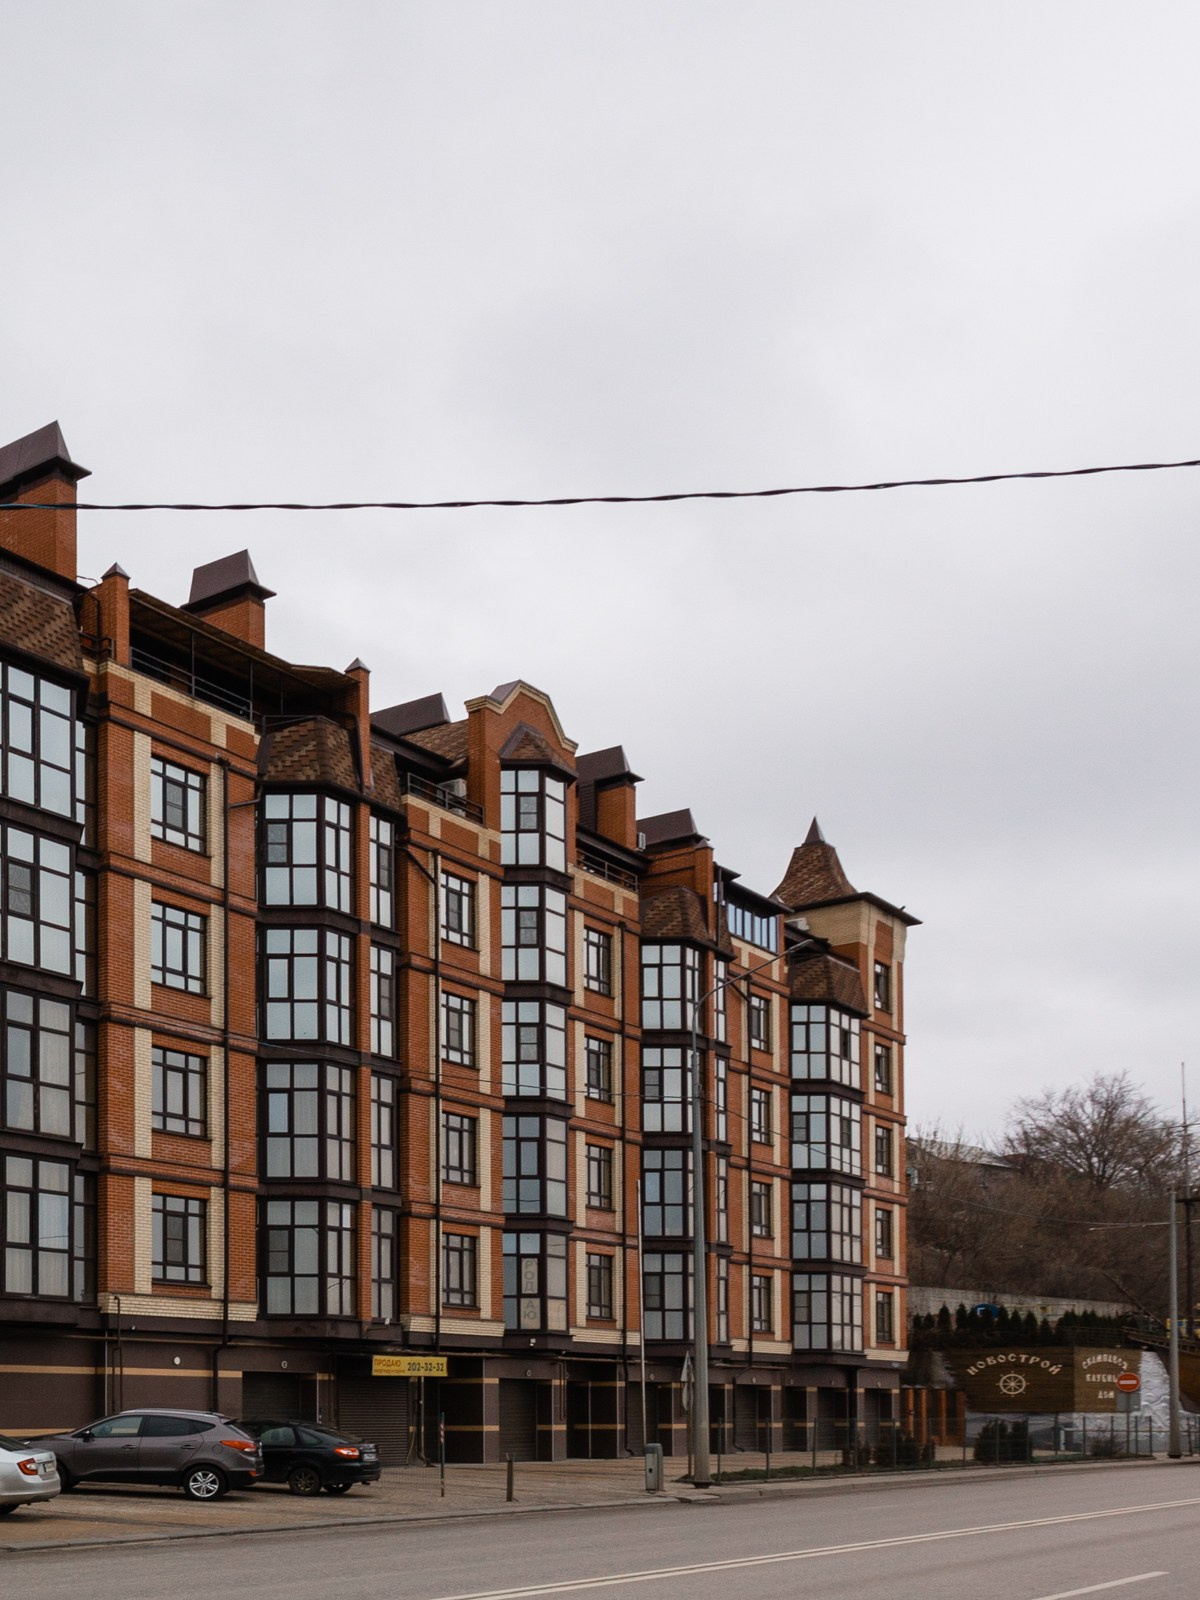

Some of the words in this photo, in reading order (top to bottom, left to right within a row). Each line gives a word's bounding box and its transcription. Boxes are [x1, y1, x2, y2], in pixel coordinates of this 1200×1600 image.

[374, 1359, 401, 1367] ПРОДАЮ
[407, 1362, 444, 1371] 202-32-32
[966, 1353, 1063, 1375] НОВОСТРОЙ
